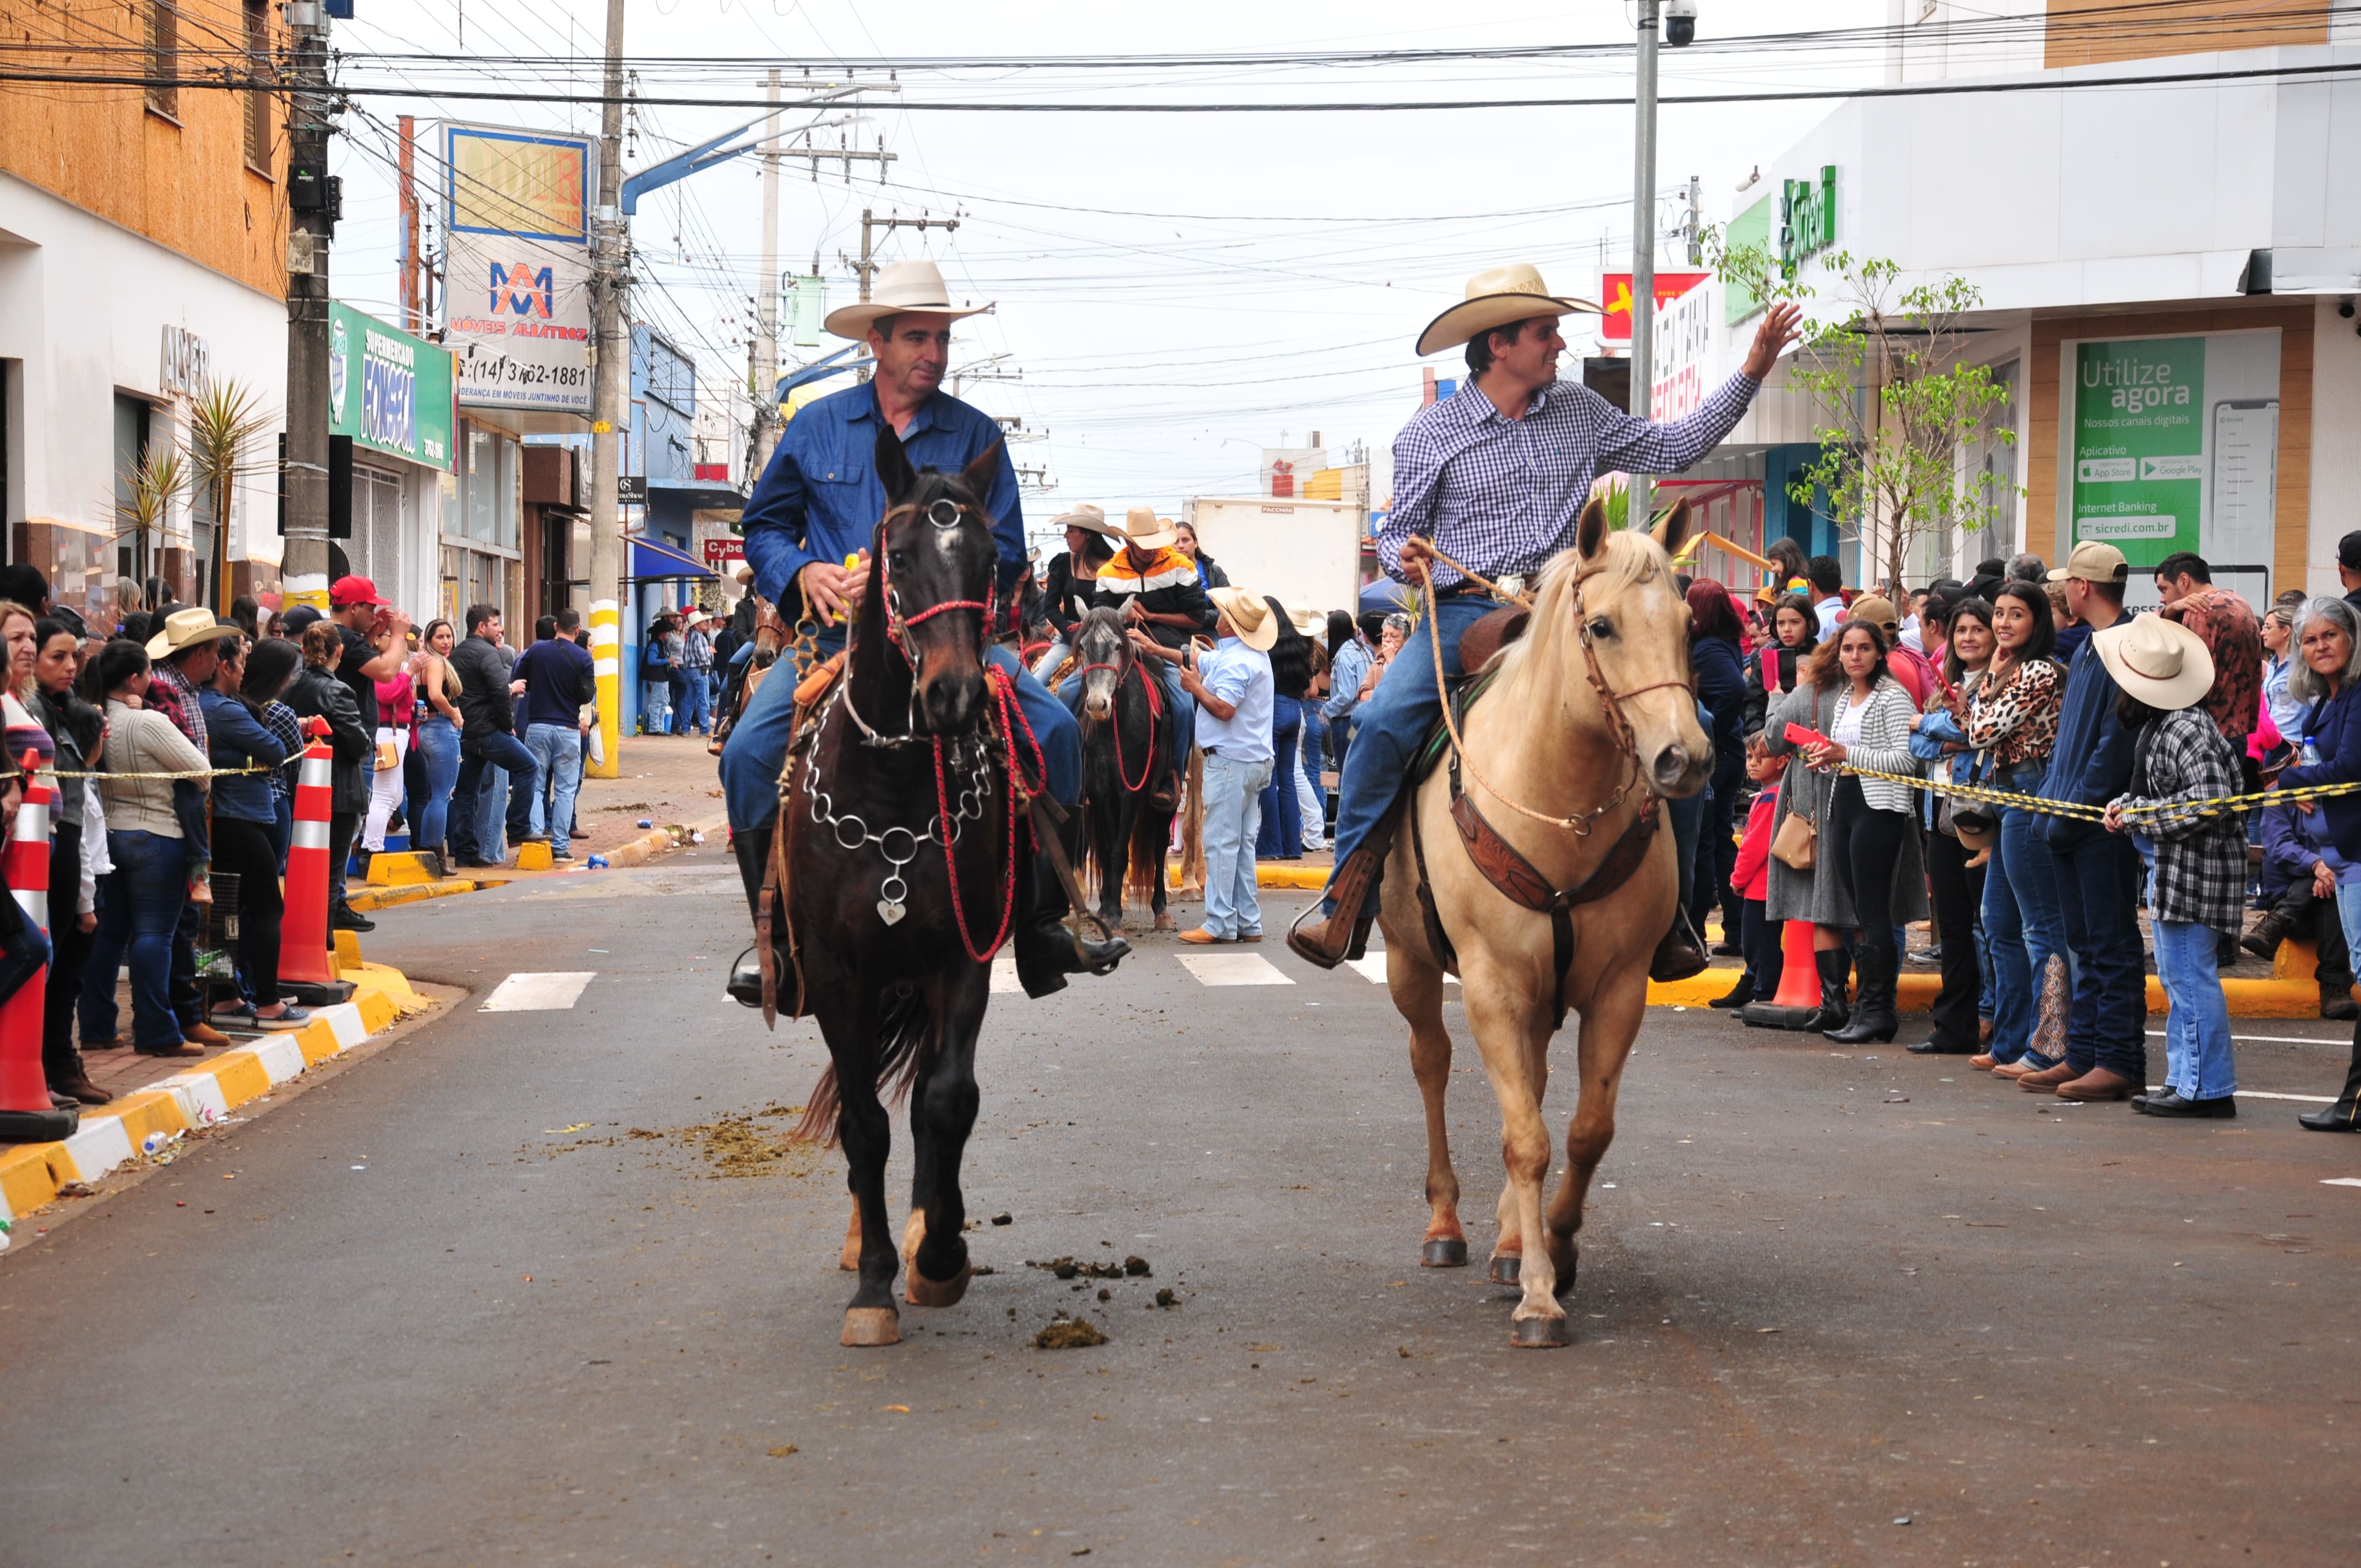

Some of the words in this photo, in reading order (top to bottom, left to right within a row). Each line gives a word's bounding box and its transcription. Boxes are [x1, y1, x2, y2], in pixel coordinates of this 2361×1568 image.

[450, 316, 507, 335] MÓVEIS
[512, 323, 588, 342] ALBATROZ
[366, 329, 415, 369] SUPERMERCADO
[2083, 358, 2171, 388] Utilize
[361, 353, 415, 454] FONSECA
[459, 387, 490, 399] IDERANÇA
[503, 389, 526, 400] MÓVEIS
[528, 393, 559, 402] JUNTINHO
[561, 395, 569, 404] DE
[572, 395, 587, 405] VOCÊ
[2111, 385, 2190, 414] agora
[2085, 417, 2119, 428] Nossos
[2121, 416, 2152, 426] canais
[2154, 414, 2189, 427] digitais
[2079, 446, 2126, 458] Aplicativo
[2095, 469, 2109, 478] App
[2111, 468, 2131, 476] Store
[2160, 466, 2186, 476] Google
[2187, 465, 2202, 475] Play
[2079, 503, 2115, 513] Internet
[2119, 502, 2157, 513] Banking
[2095, 522, 2169, 534] sicredi.com.br
[708, 542, 743, 558] Cybe
